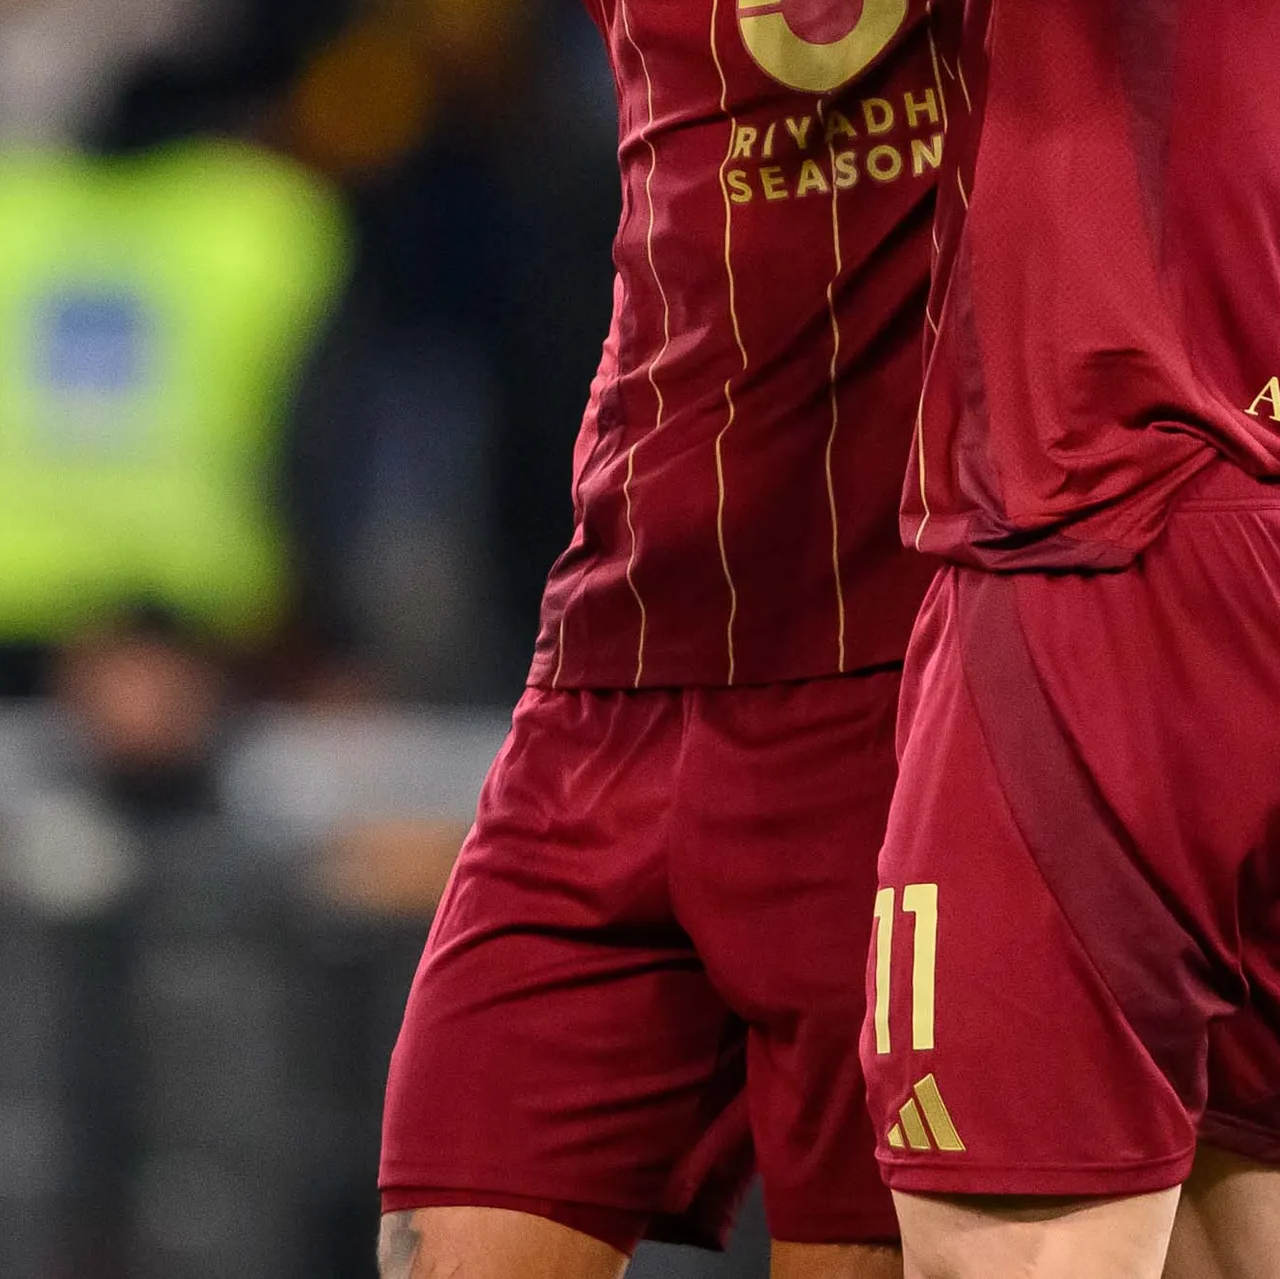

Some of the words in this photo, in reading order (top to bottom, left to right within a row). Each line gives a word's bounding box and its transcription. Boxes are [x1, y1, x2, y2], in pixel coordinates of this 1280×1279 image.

[731, 88, 939, 159] RIYADH
[727, 135, 944, 203] SEASON
[874, 883, 939, 1054] 11
